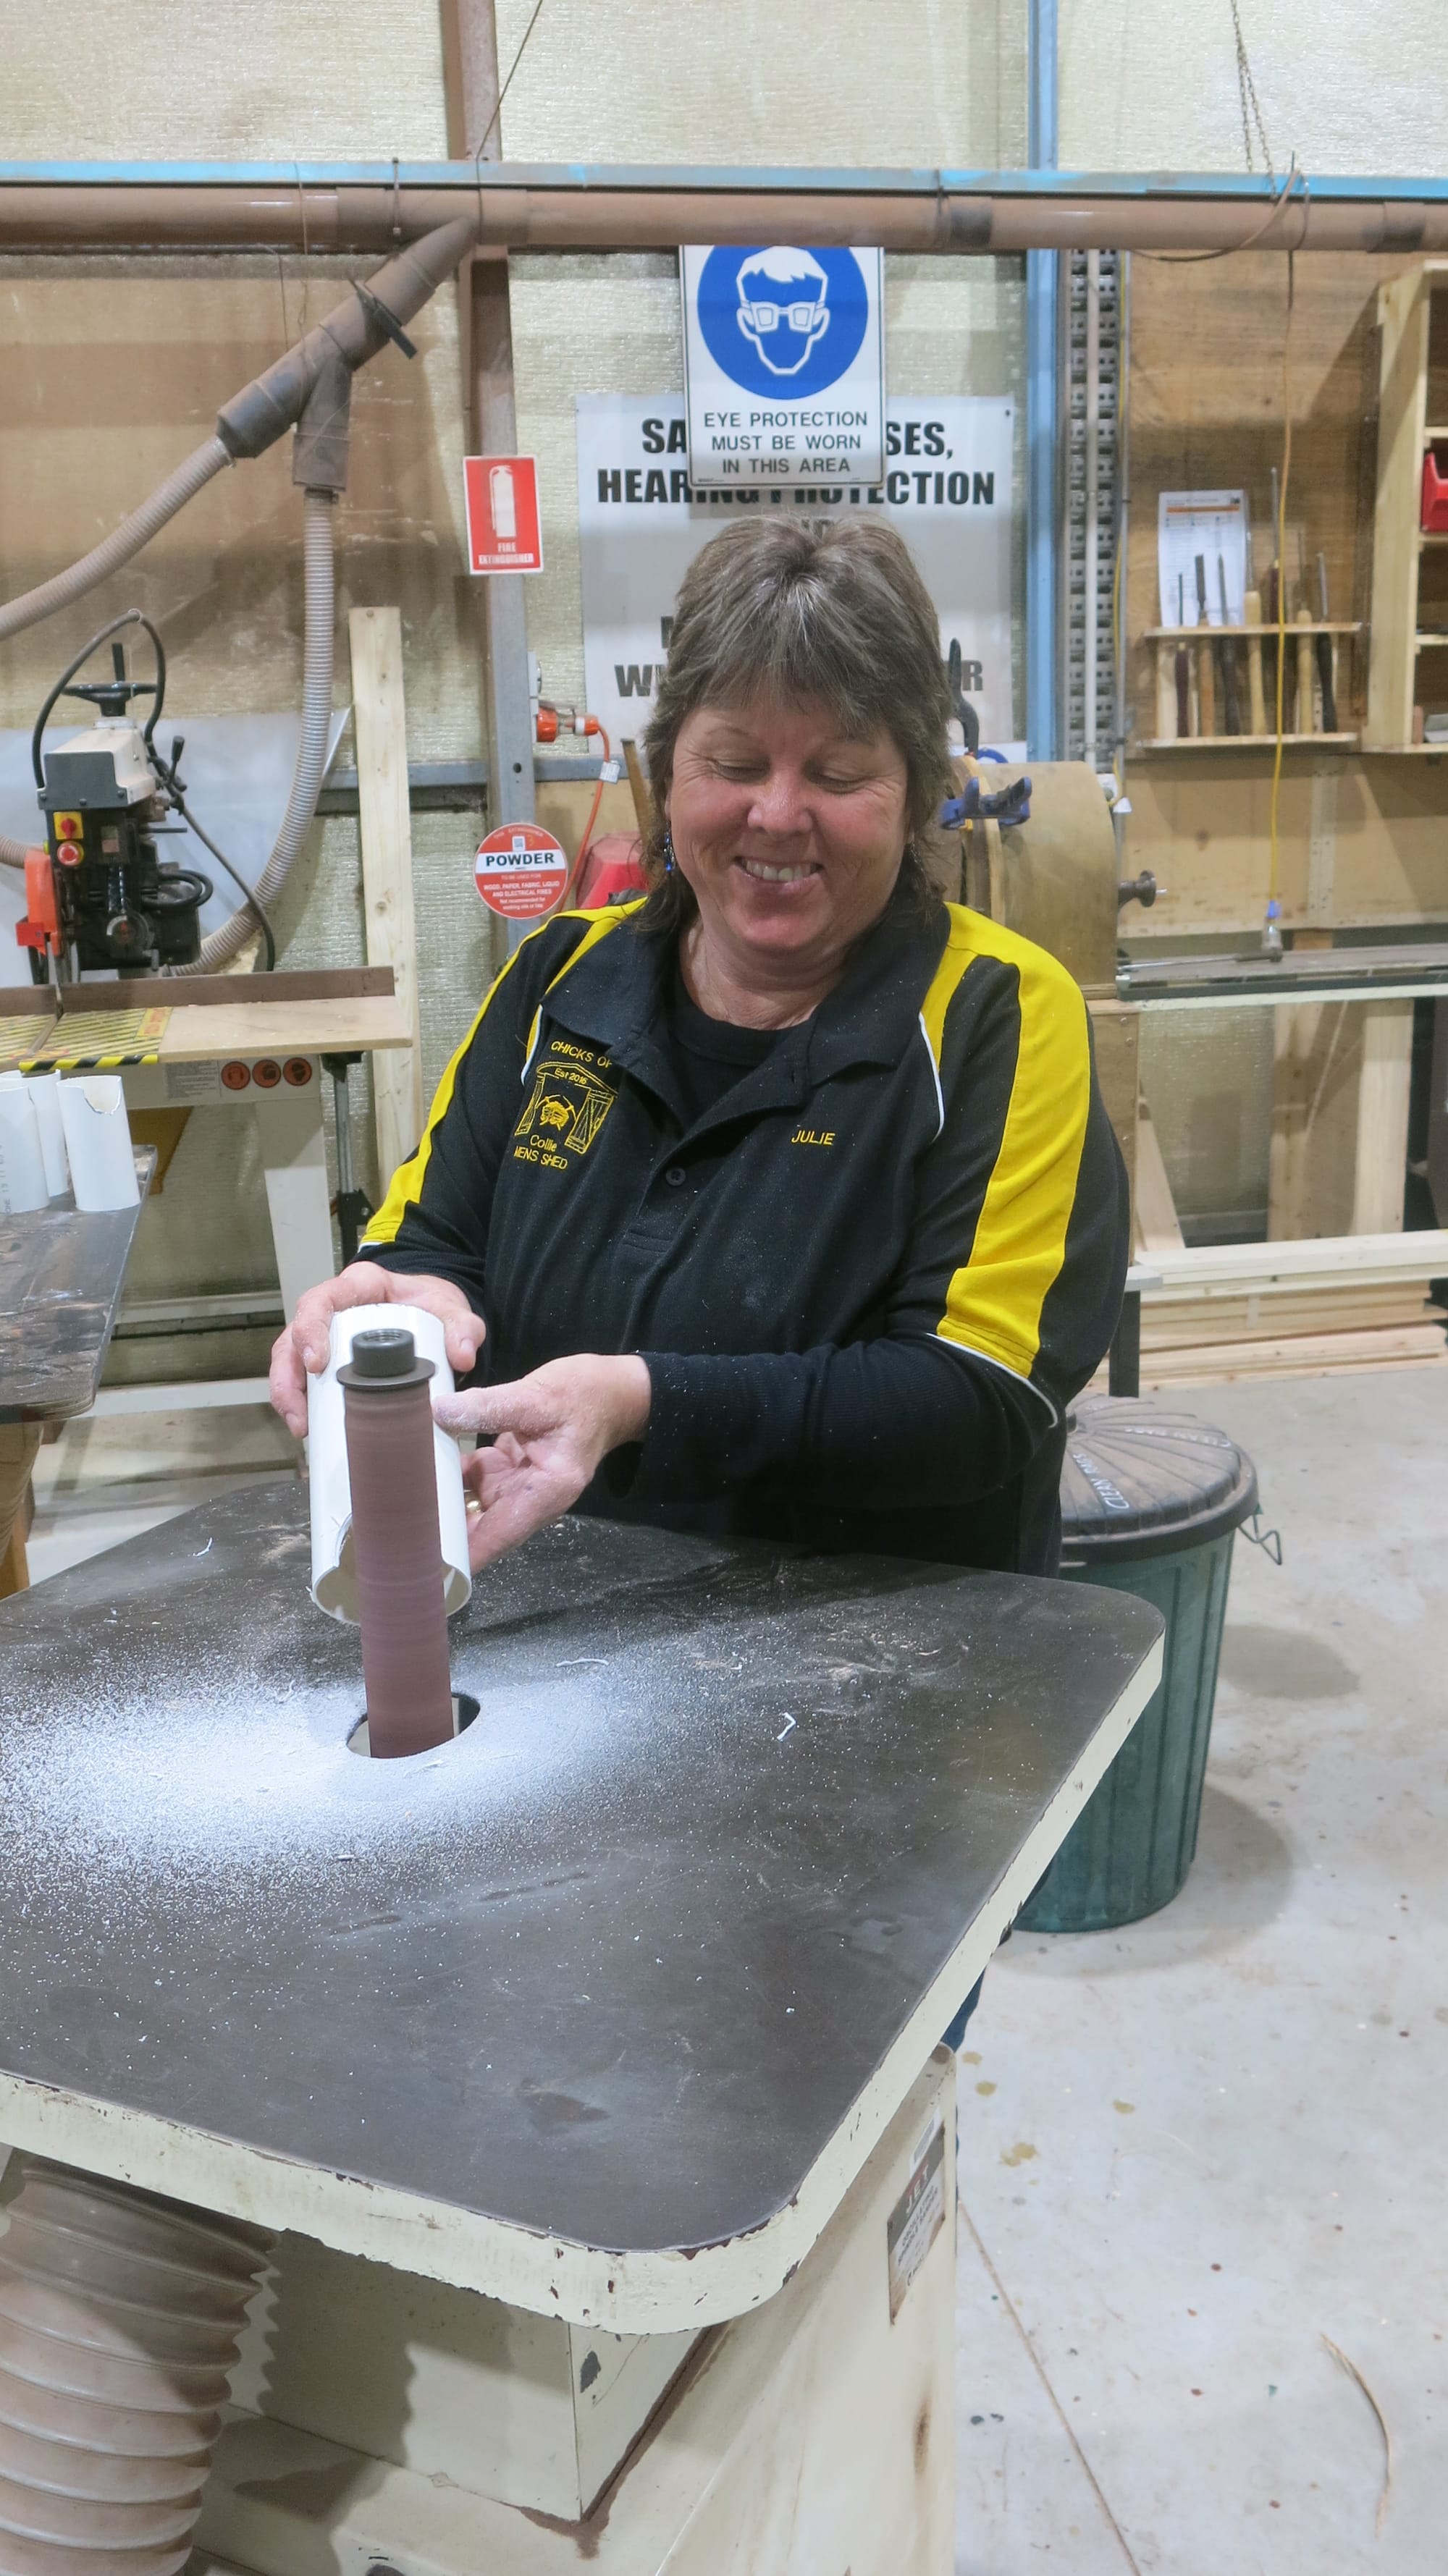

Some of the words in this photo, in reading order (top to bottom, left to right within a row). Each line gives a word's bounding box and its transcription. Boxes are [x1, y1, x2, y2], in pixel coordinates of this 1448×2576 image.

[704, 412, 741, 427] EYE
[750, 411, 867, 427] PROTECTION
[712, 435, 762, 450] MUST
[772, 435, 795, 449] BE
[805, 435, 861, 449] WORN
[723, 458, 739, 473] IN
[749, 458, 790, 473] THIS
[799, 457, 851, 472] AREA
[486, 853, 555, 866] POWDER
[551, 1041, 594, 1063] CHICKS
[555, 1068, 569, 1079] Est
[530, 1134, 557, 1152] Collie
[791, 1130, 835, 1146] JULIE
[540, 1153, 568, 1170] SHED
[906, 2163, 929, 2215] JET
